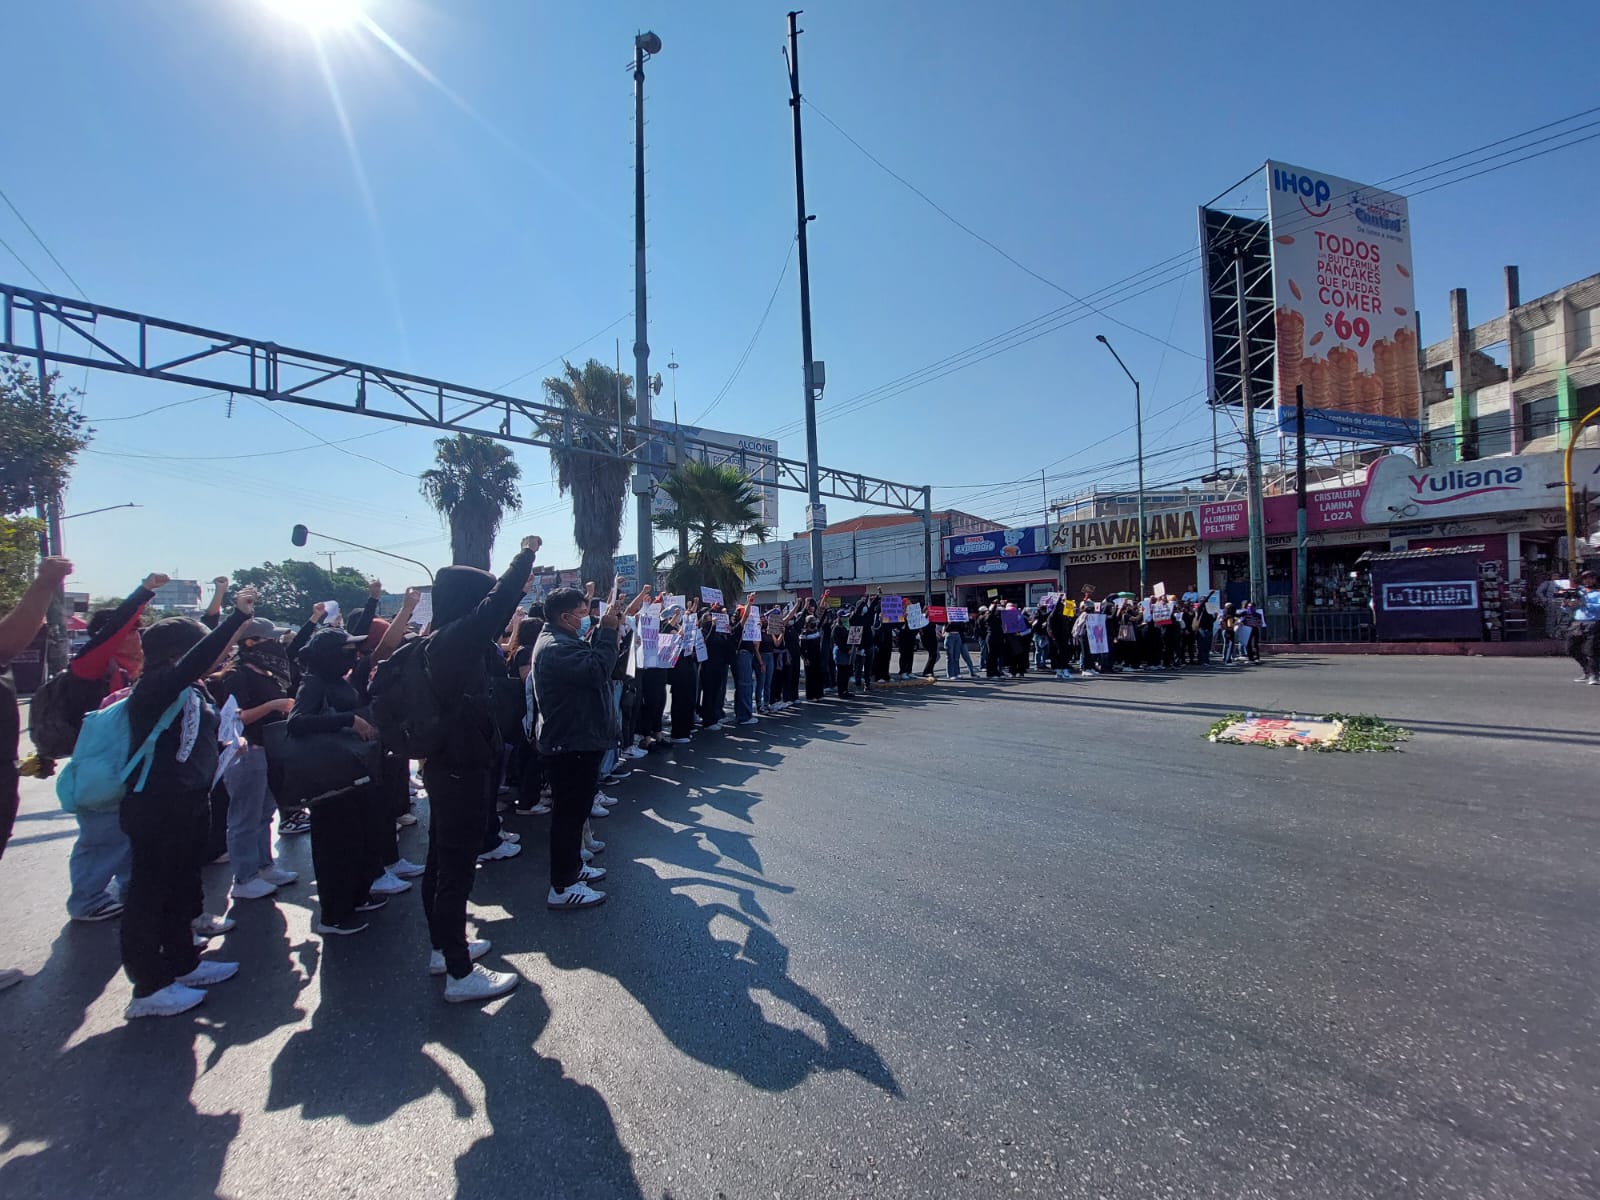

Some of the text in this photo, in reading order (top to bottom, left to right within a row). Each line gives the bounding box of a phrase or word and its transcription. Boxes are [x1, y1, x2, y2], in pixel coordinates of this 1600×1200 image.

[1315, 231, 1380, 263] TODOS
[1317, 260, 1381, 284] PANCAKES
[1328, 254, 1380, 272] BUTTERMILK
[1317, 275, 1380, 296] QUE PUEDAS
[1319, 287, 1382, 315] COMER
[1325, 310, 1370, 347] $69
[738, 440, 773, 453] ALCIONE
[1408, 466, 1523, 494] Yuliana
[1314, 489, 1361, 503] CRISTALERIA
[1205, 503, 1243, 515] PLASTICO
[1320, 500, 1354, 512] LAMINA
[1203, 513, 1240, 524] ALUMINIO
[1324, 511, 1352, 521] LOZA
[1205, 523, 1236, 533] PELTRE
[1069, 545, 1196, 563] TACOS TORTA ALAMBRES
